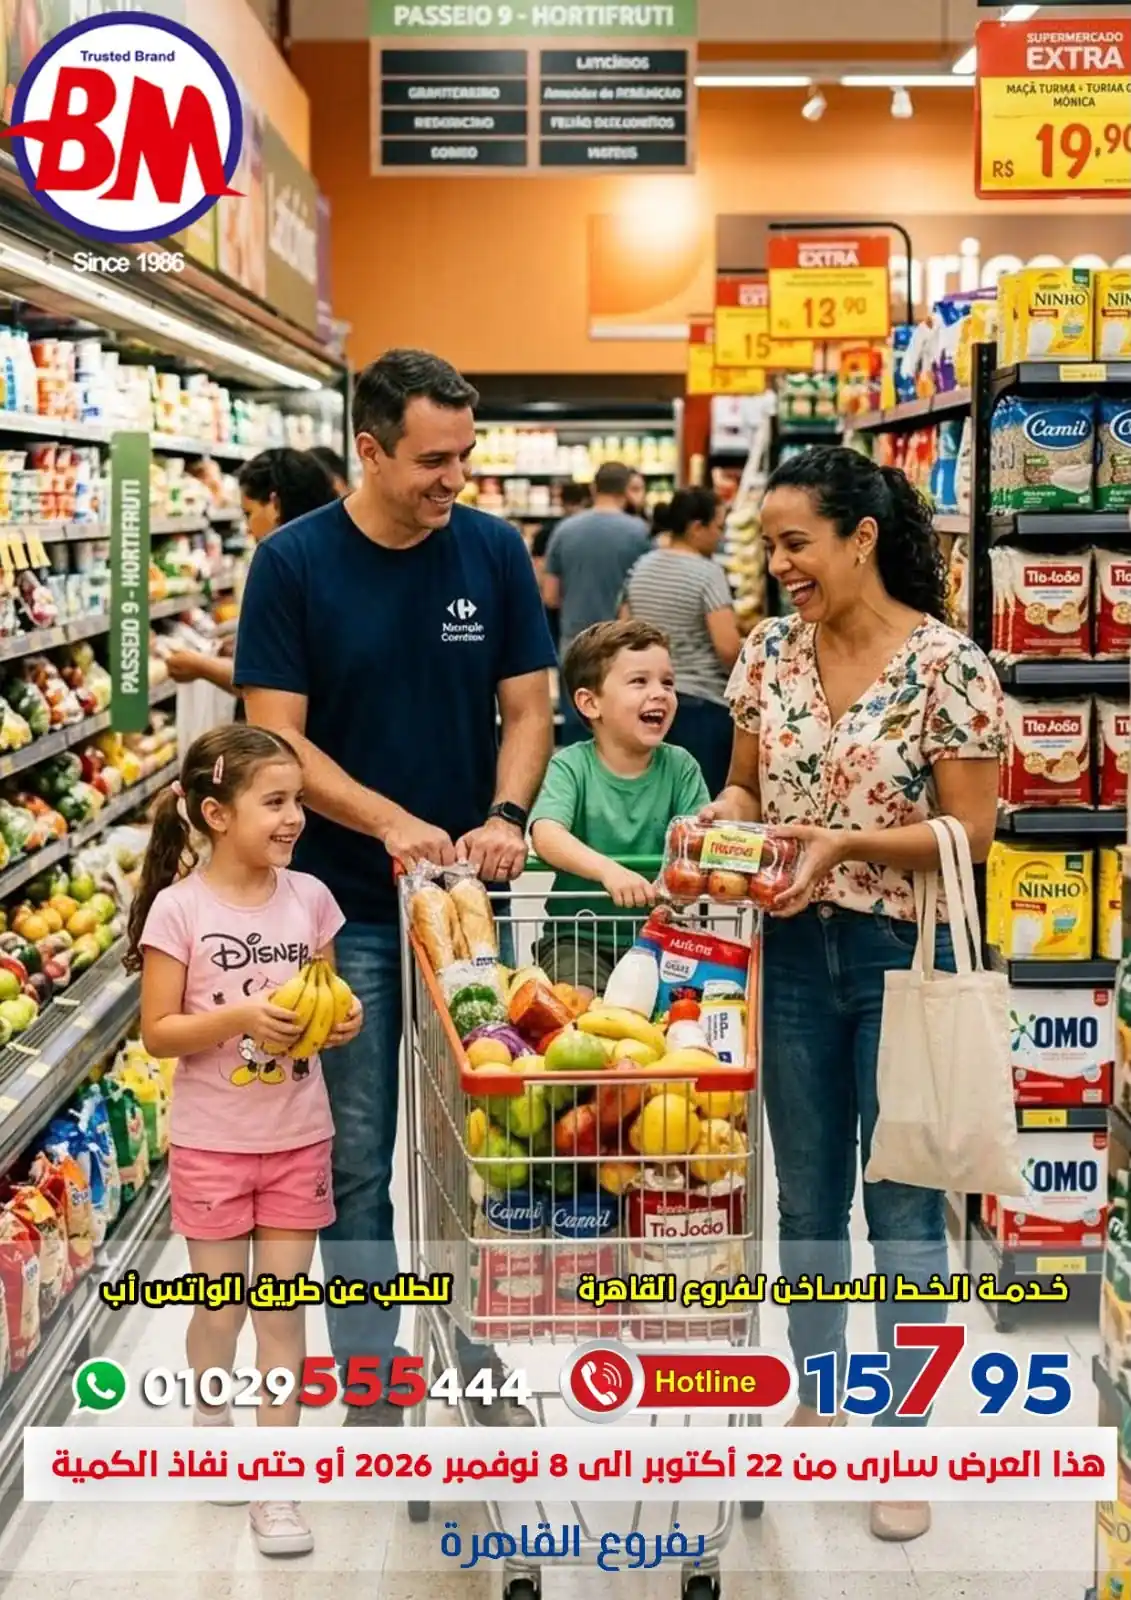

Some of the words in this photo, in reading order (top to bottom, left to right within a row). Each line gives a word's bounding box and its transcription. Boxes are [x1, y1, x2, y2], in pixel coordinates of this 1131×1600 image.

[393, 5, 493, 27] PASSEIO
[498, 6, 512, 27] 9
[531, 5, 674, 27] HORTIFRUTI
[1026, 31, 1124, 44] SUPERMERCADO
[1026, 46, 1125, 71] EXTRA
[1034, 292, 1086, 306] NINHO
[802, 297, 837, 329] 13
[1031, 418, 1087, 437] Camil
[121, 479, 140, 587] HORTIFRUTI
[1018, 881, 1081, 899] NINHO
[1034, 1016, 1098, 1049] OMO
[1033, 1160, 1098, 1193] OMO
[649, 1221, 677, 1238] Tio
